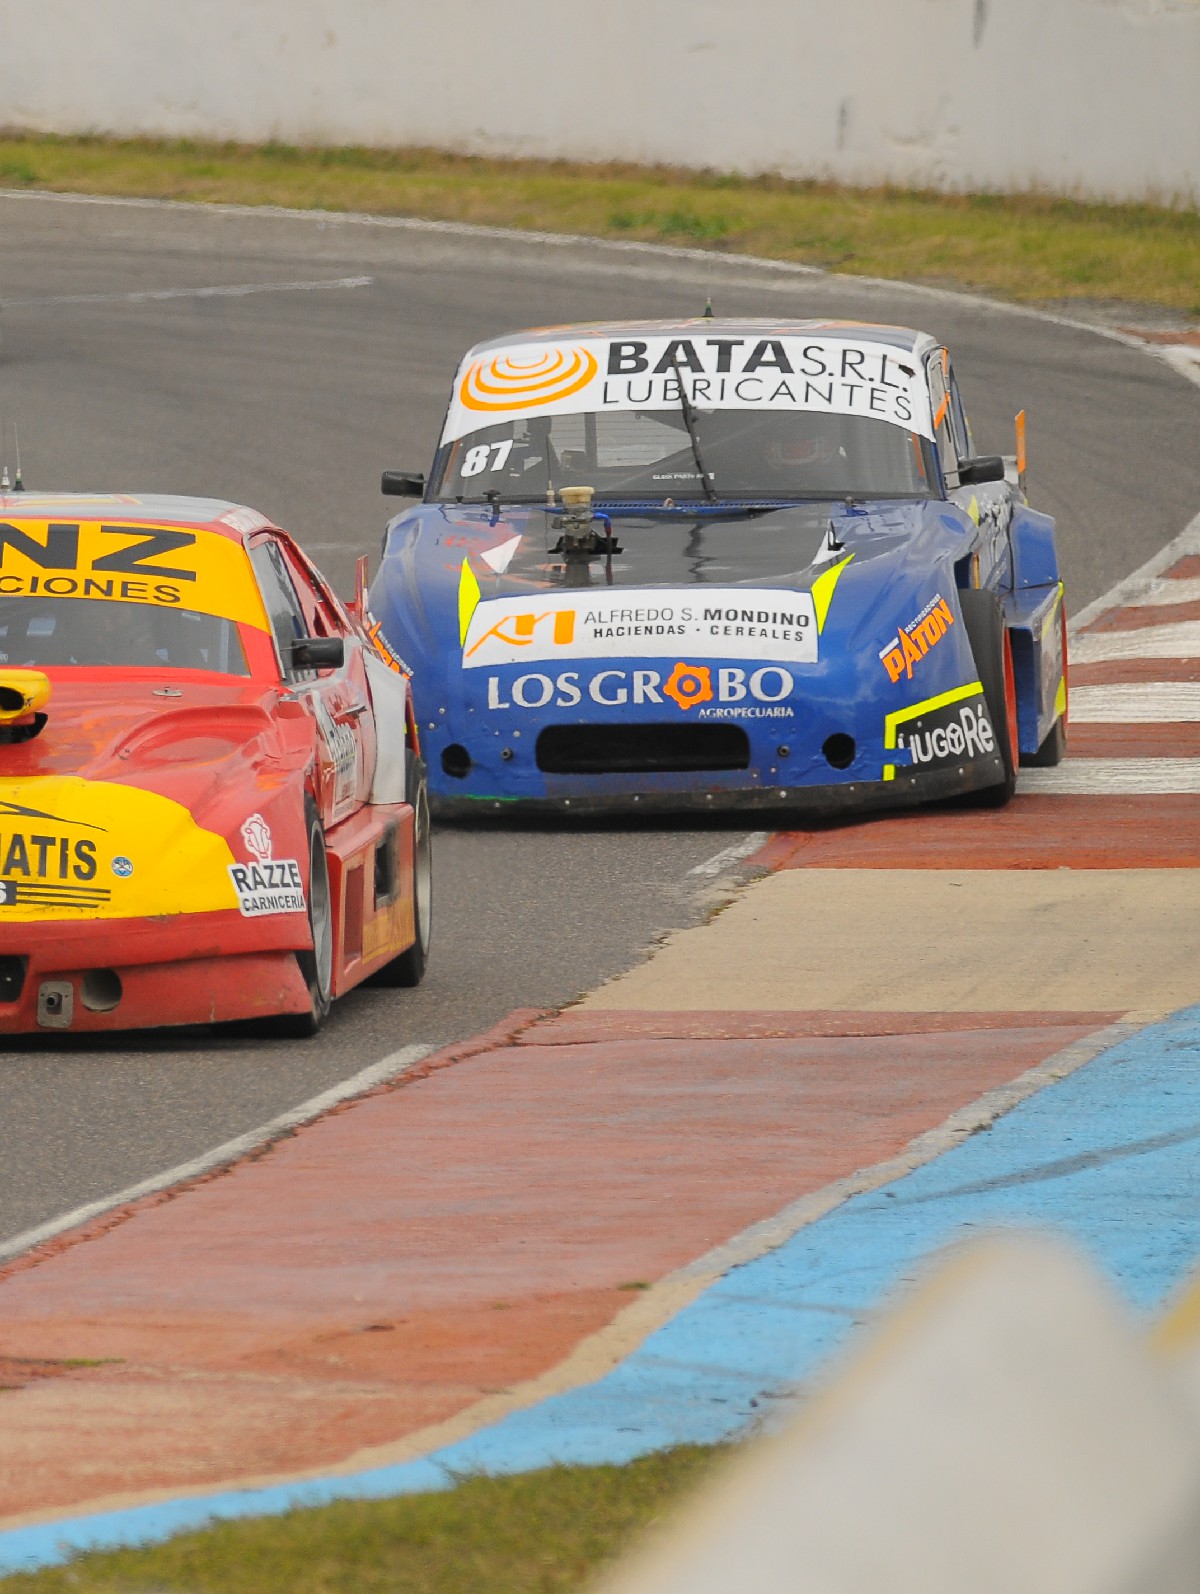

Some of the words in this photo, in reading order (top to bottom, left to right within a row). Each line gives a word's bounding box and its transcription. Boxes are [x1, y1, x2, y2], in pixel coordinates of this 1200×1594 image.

[607, 339, 796, 375] BATA
[799, 345, 909, 393] S.R.L.
[602, 377, 913, 421] LUBRICANTES
[460, 439, 513, 477] 87
[584, 607, 674, 625] ALFREDO
[680, 608, 698, 622] S.
[702, 608, 811, 628] MONDINO
[592, 624, 687, 639] HACIENDAS
[709, 624, 805, 642] CEREALES
[882, 599, 955, 685] PATON
[698, 706, 795, 718] AGROPECUARIA
[231, 862, 302, 893] RAZZE
[242, 891, 305, 912] CARNICERÍA
